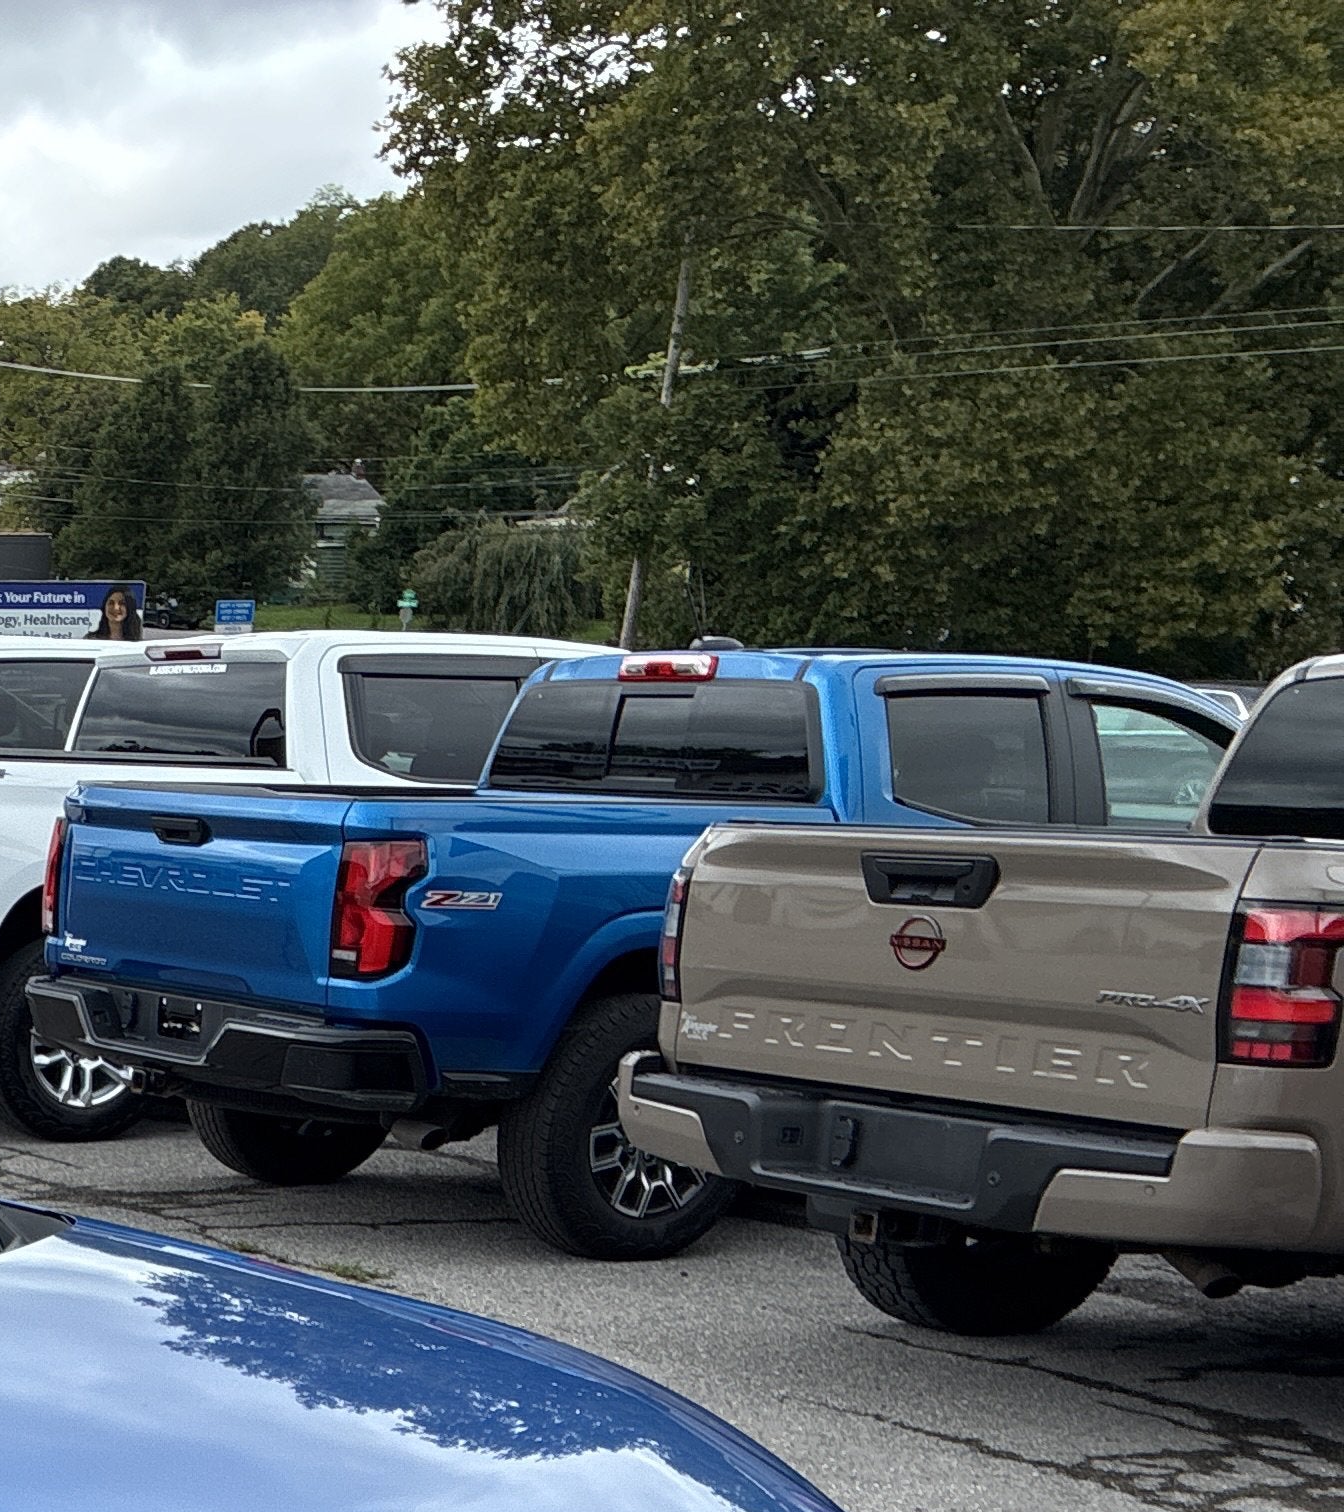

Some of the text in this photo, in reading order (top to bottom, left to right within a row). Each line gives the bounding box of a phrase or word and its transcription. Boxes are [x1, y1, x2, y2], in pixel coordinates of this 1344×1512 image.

[5, 591, 31, 604] Your
[32, 591, 72, 604] Future
[73, 591, 85, 604] in
[23, 614, 93, 627] Healthcare,
[715, 1007, 1152, 1089] FRONTIER
